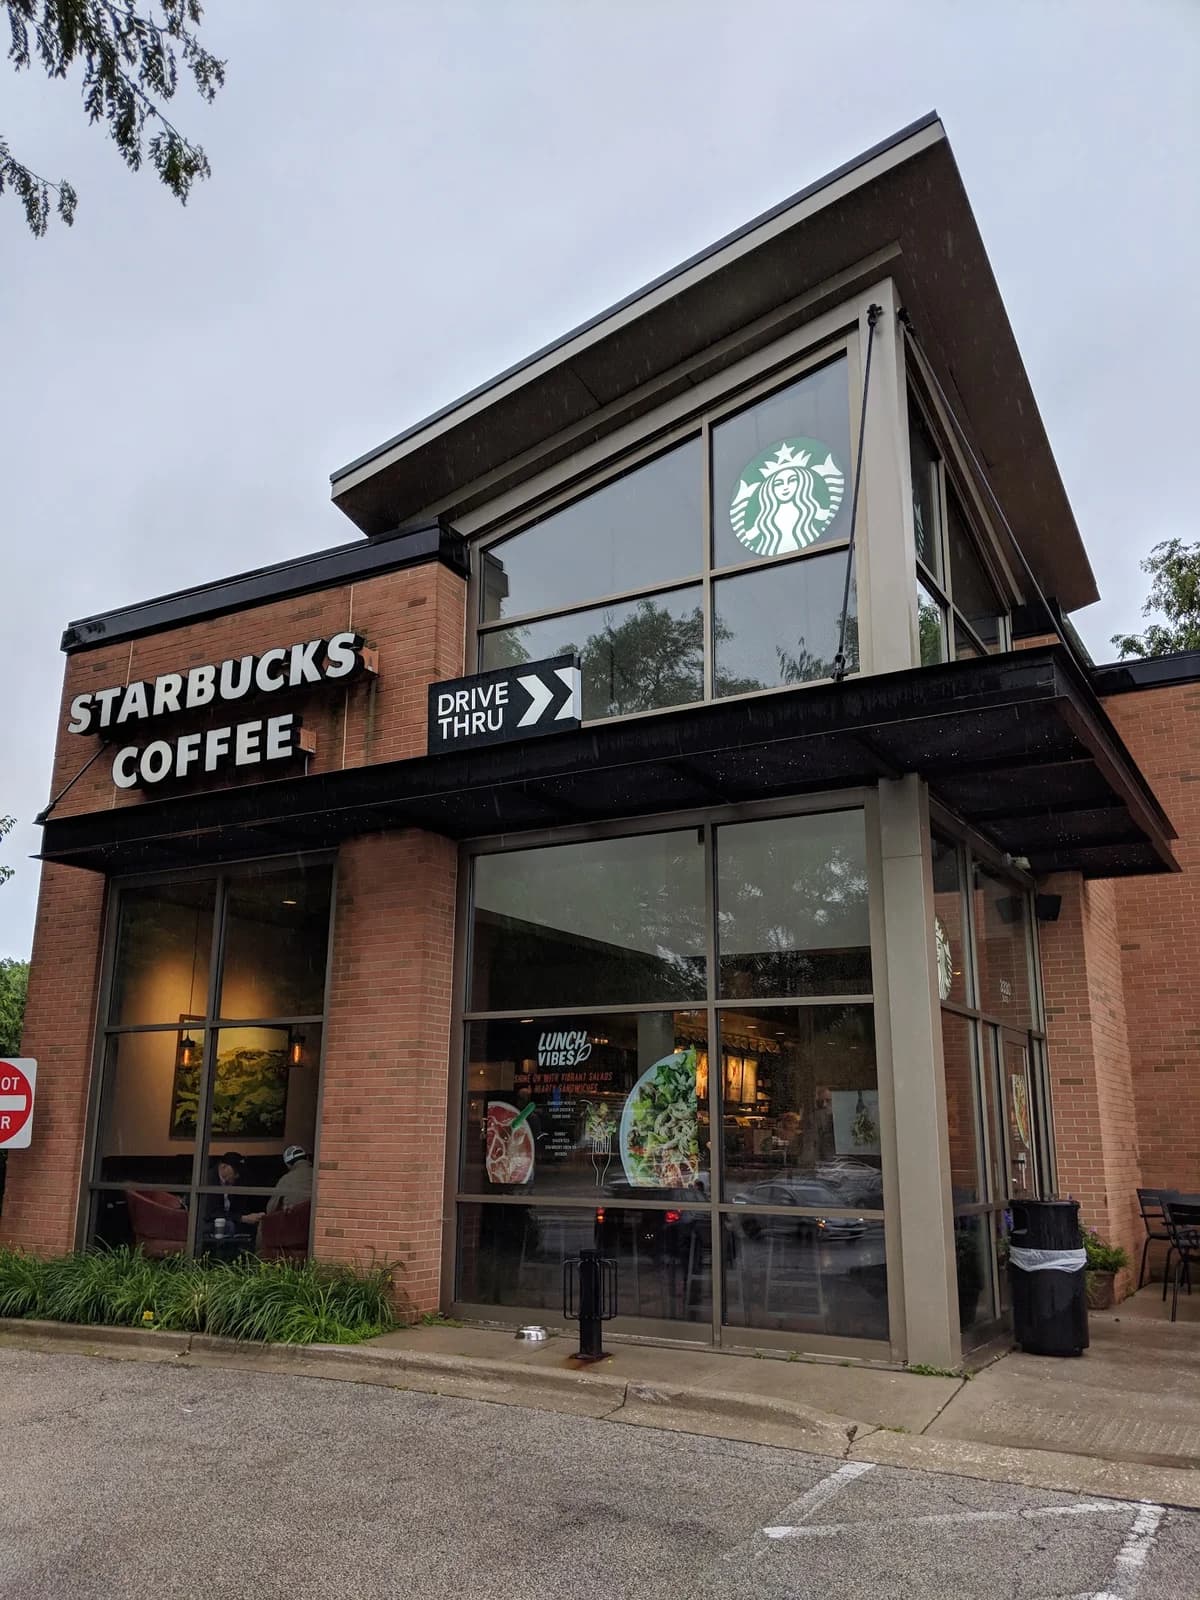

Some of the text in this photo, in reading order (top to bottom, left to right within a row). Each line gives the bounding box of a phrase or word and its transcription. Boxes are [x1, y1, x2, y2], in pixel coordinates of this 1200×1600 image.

[67, 632, 356, 734] STARBUCKS
[437, 682, 509, 716] DRIVE
[437, 708, 504, 740] THRU
[111, 713, 294, 790] COFFEE
[538, 1031, 587, 1051] LUNCH
[538, 1050, 575, 1066] VIBES
[0, 1077, 20, 1090] OT
[561, 1072, 587, 1081] VIBRANT
[589, 1071, 613, 1081] SALADS
